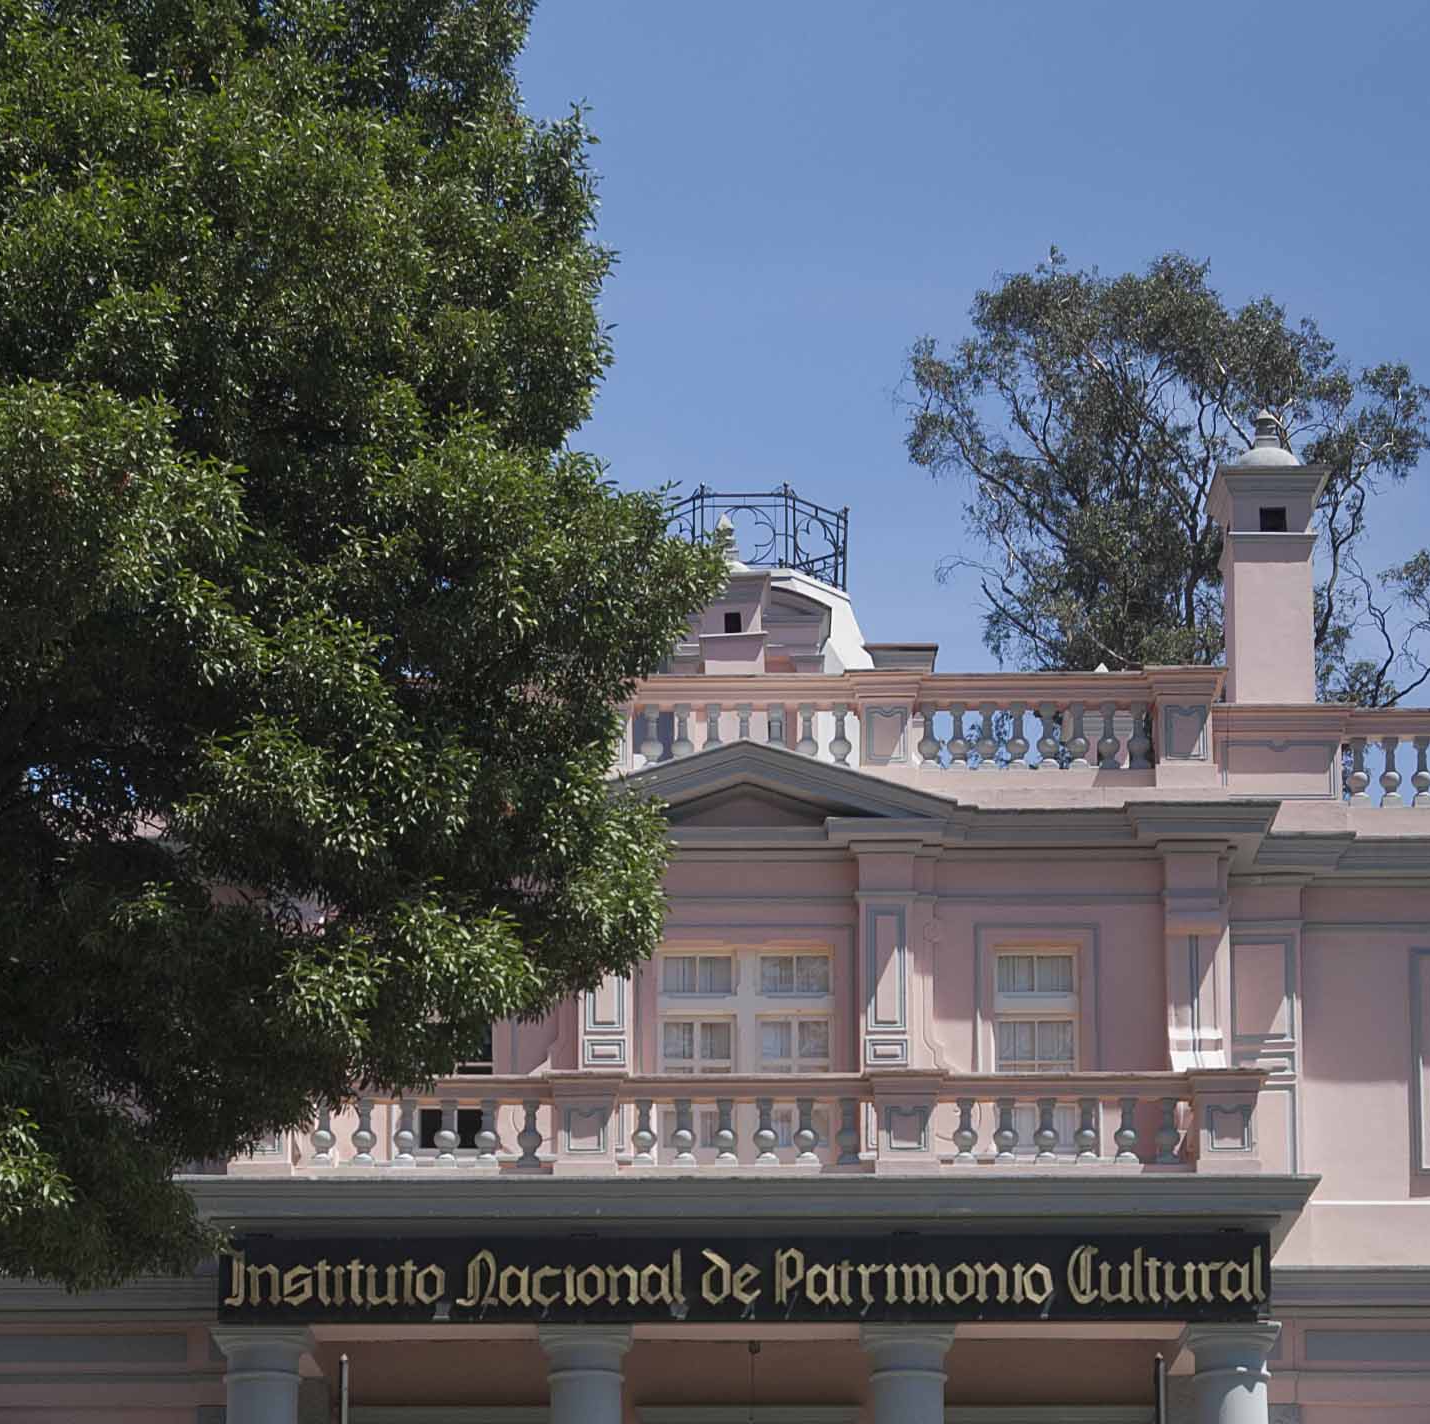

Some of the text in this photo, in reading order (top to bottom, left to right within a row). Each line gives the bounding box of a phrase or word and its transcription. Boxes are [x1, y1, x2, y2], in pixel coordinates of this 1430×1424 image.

[223, 1245, 1267, 1307] Instituto Nacional de Patrimonio Cultural
